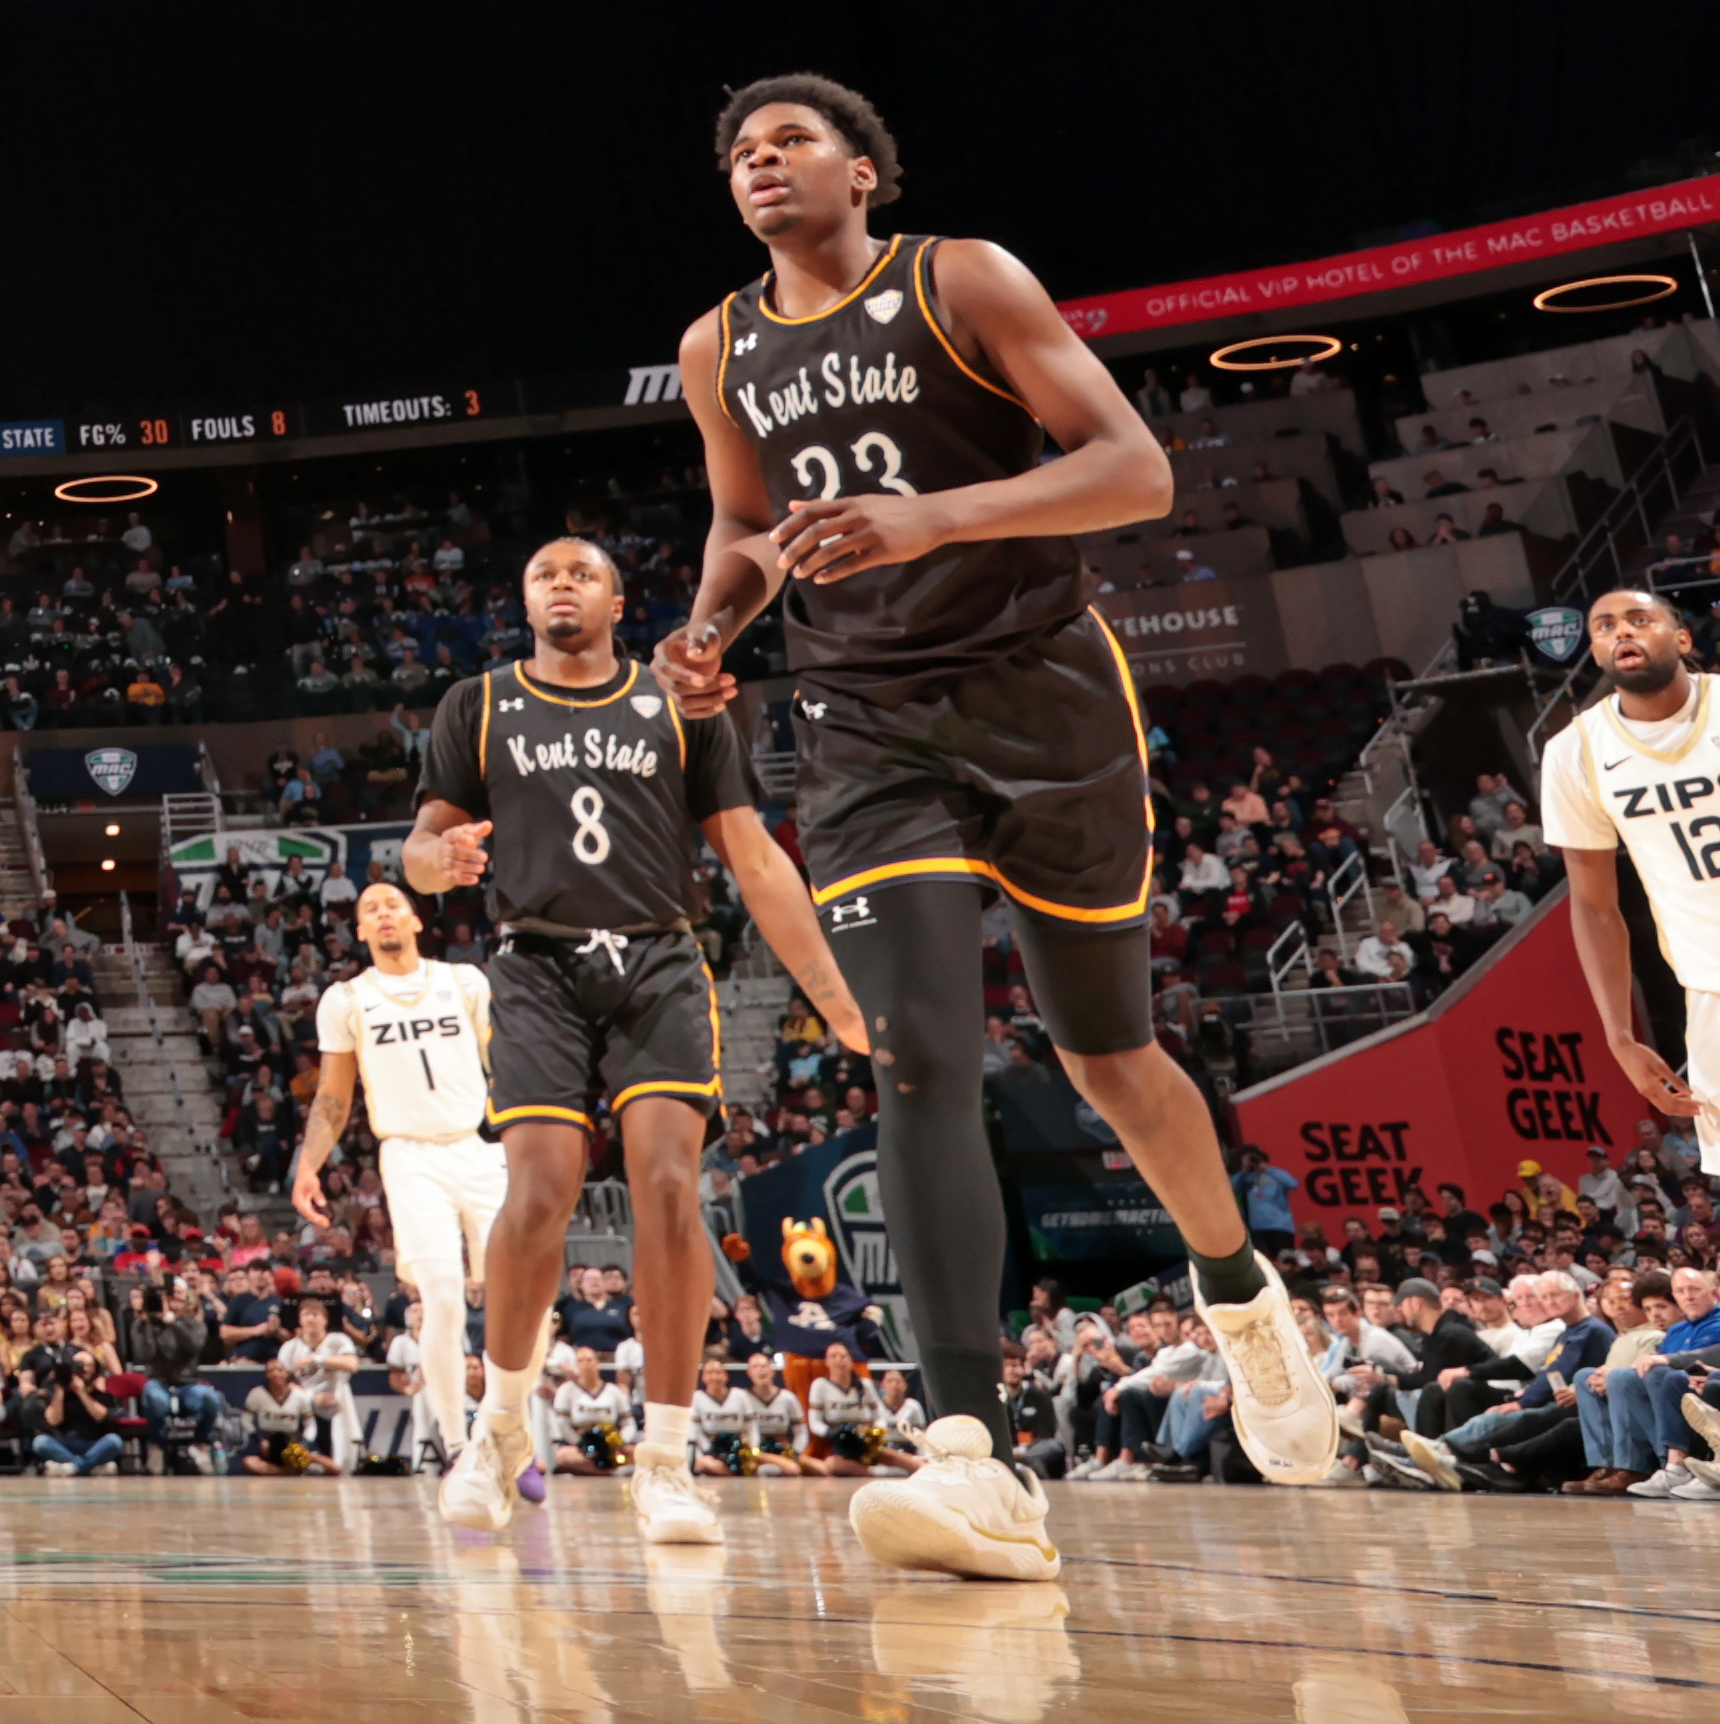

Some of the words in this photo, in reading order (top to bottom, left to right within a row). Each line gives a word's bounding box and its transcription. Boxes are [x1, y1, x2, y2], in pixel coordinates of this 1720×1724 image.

[1146, 285, 1252, 318] OFFICIAL
[1257, 276, 1300, 298] VIP
[1305, 262, 1384, 291] HOTEL
[1391, 250, 1427, 276] OF
[1431, 238, 1481, 265] THE
[1486, 225, 1545, 257] MAC
[1550, 192, 1716, 243] BASKETBALL
[1, 426, 56, 451] STATE
[79, 423, 127, 447] FG%
[140, 418, 169, 446] 30
[191, 414, 255, 442] FOULS
[271, 410, 286, 437] 8
[341, 394, 452, 429] TIMEOUTS:
[464, 388, 481, 417] 3
[736, 366, 819, 439] Kent
[820, 350, 920, 409] State
[506, 732, 579, 777] Kent
[583, 727, 659, 778] State
[1612, 773, 1720, 819] ZIP
[570, 784, 611, 866] 8
[370, 1015, 461, 1046] ZIPS
[1495, 1026, 1587, 1084] SEAT
[419, 1047, 436, 1091] 1
[1299, 1120, 1410, 1162] SEAT
[1506, 1087, 1615, 1147] GEEK
[1303, 1166, 1433, 1208] GEEK
